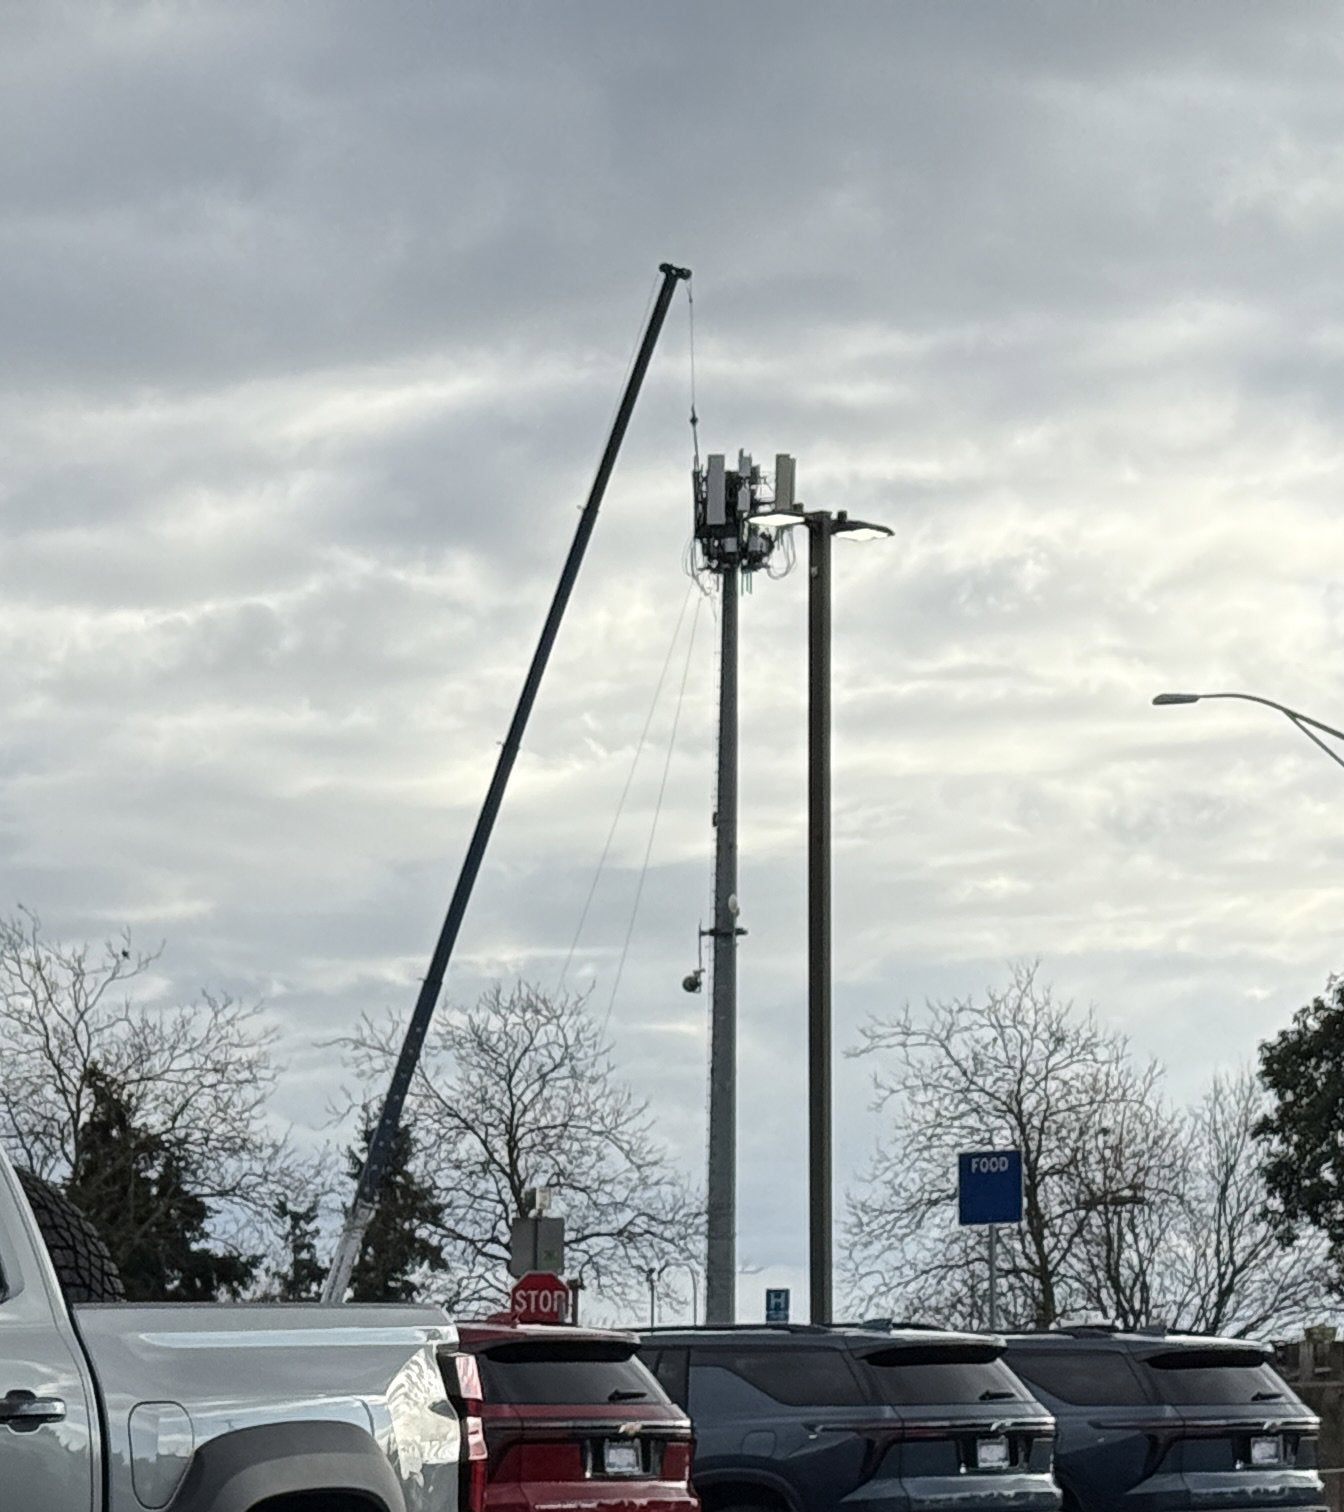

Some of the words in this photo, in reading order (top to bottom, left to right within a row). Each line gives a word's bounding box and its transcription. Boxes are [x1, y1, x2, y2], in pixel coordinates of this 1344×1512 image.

[971, 1156, 1009, 1174] FOOD
[514, 1289, 567, 1313] STOP
[769, 1292, 786, 1309] H
